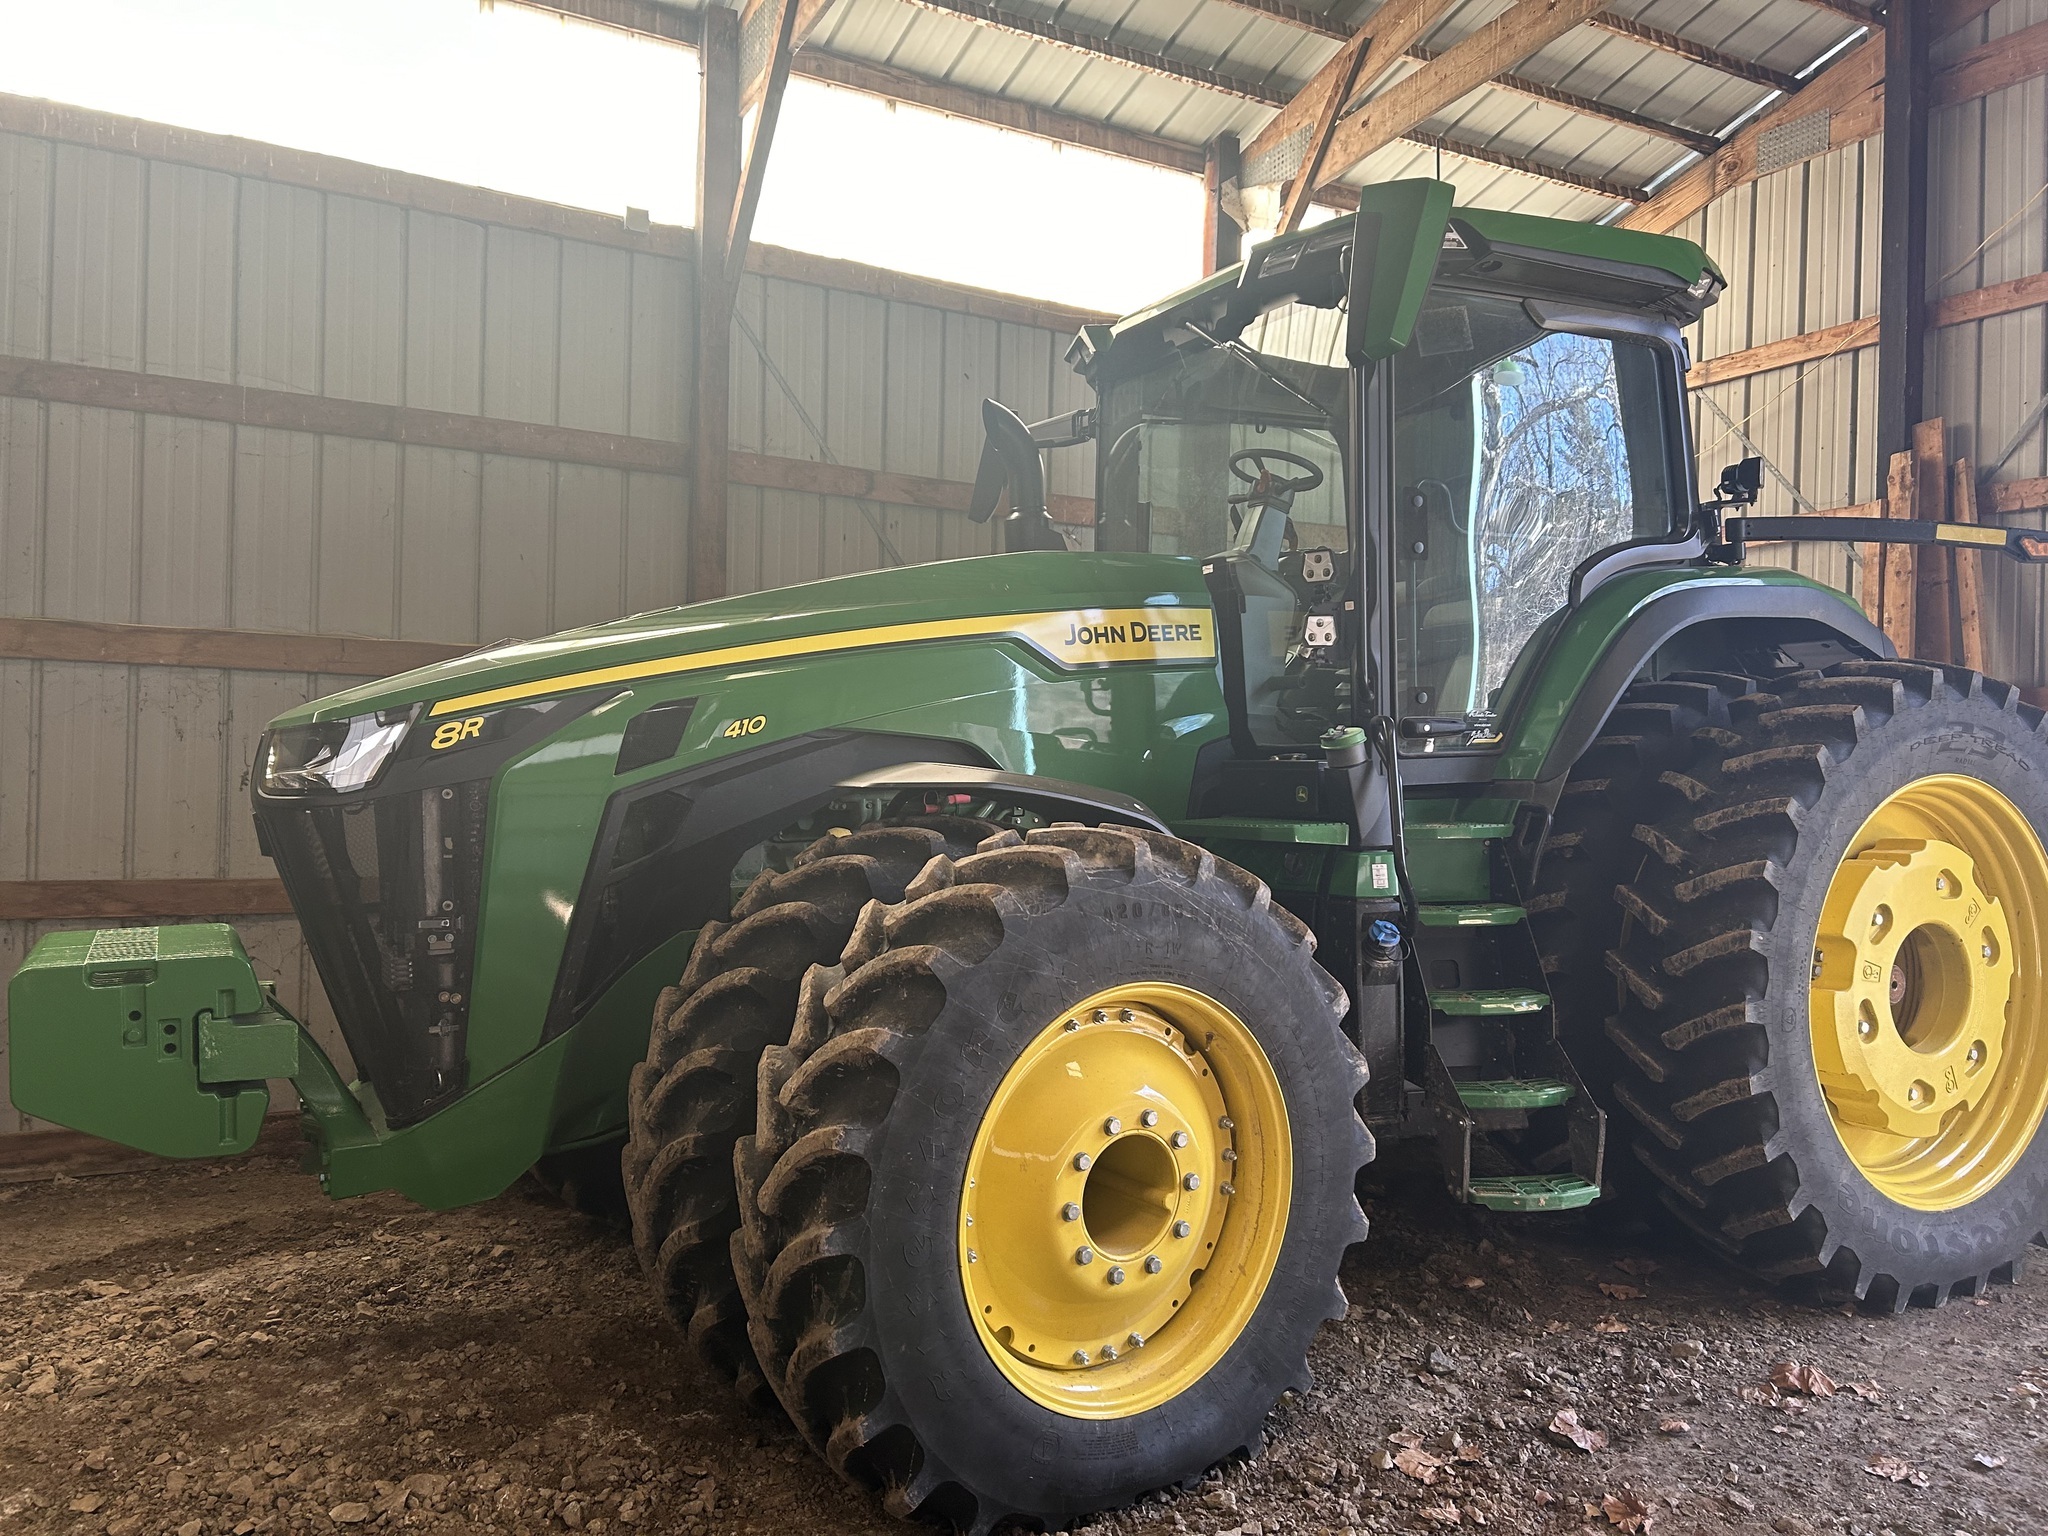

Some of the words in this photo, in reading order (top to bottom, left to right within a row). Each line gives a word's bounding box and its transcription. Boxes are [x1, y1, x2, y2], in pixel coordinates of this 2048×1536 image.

[1064, 623, 1127, 646] JOHN
[1129, 621, 1203, 643] DEERE
[430, 716, 485, 750] 8R
[723, 715, 767, 738] 410
